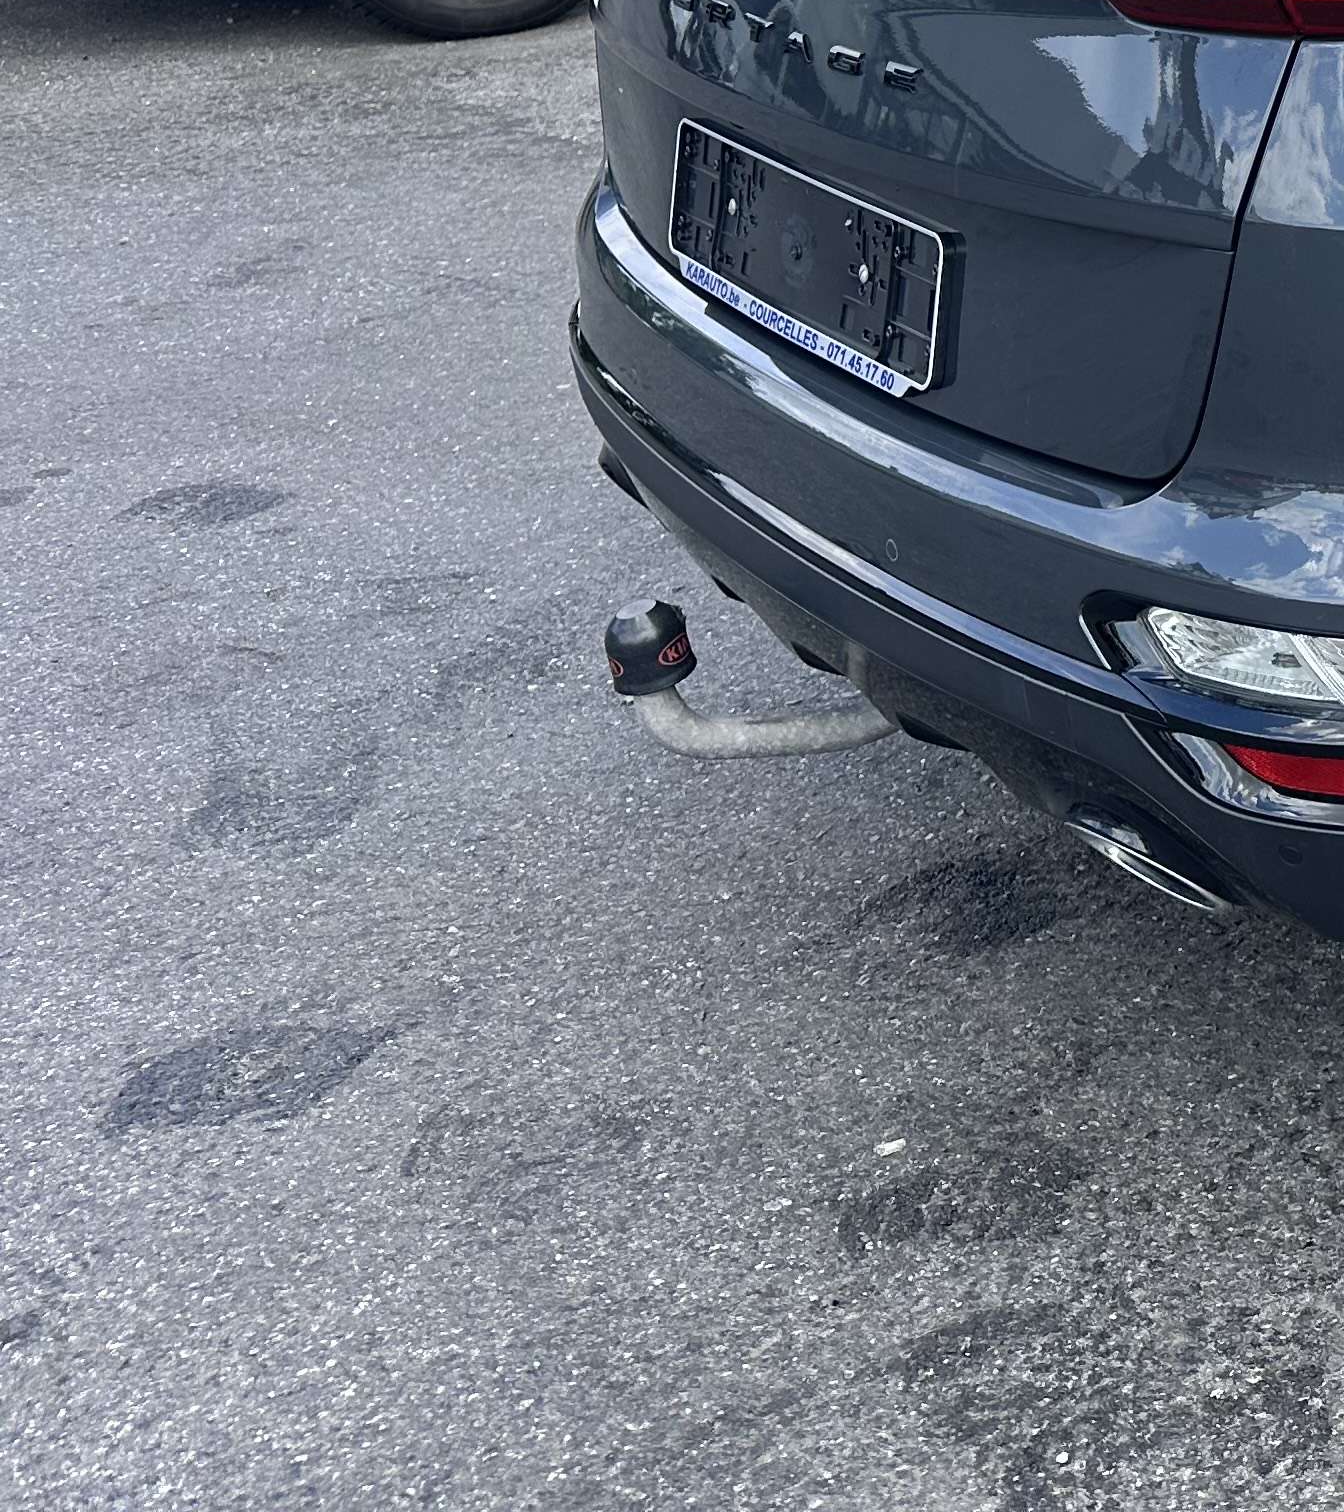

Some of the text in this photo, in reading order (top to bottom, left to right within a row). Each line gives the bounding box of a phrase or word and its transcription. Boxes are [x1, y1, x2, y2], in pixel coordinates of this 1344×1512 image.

[685, 262, 740, 308] KARAUTO.be
[749, 299, 819, 351] COURCELLES
[826, 341, 895, 390] 071.45.17.60
